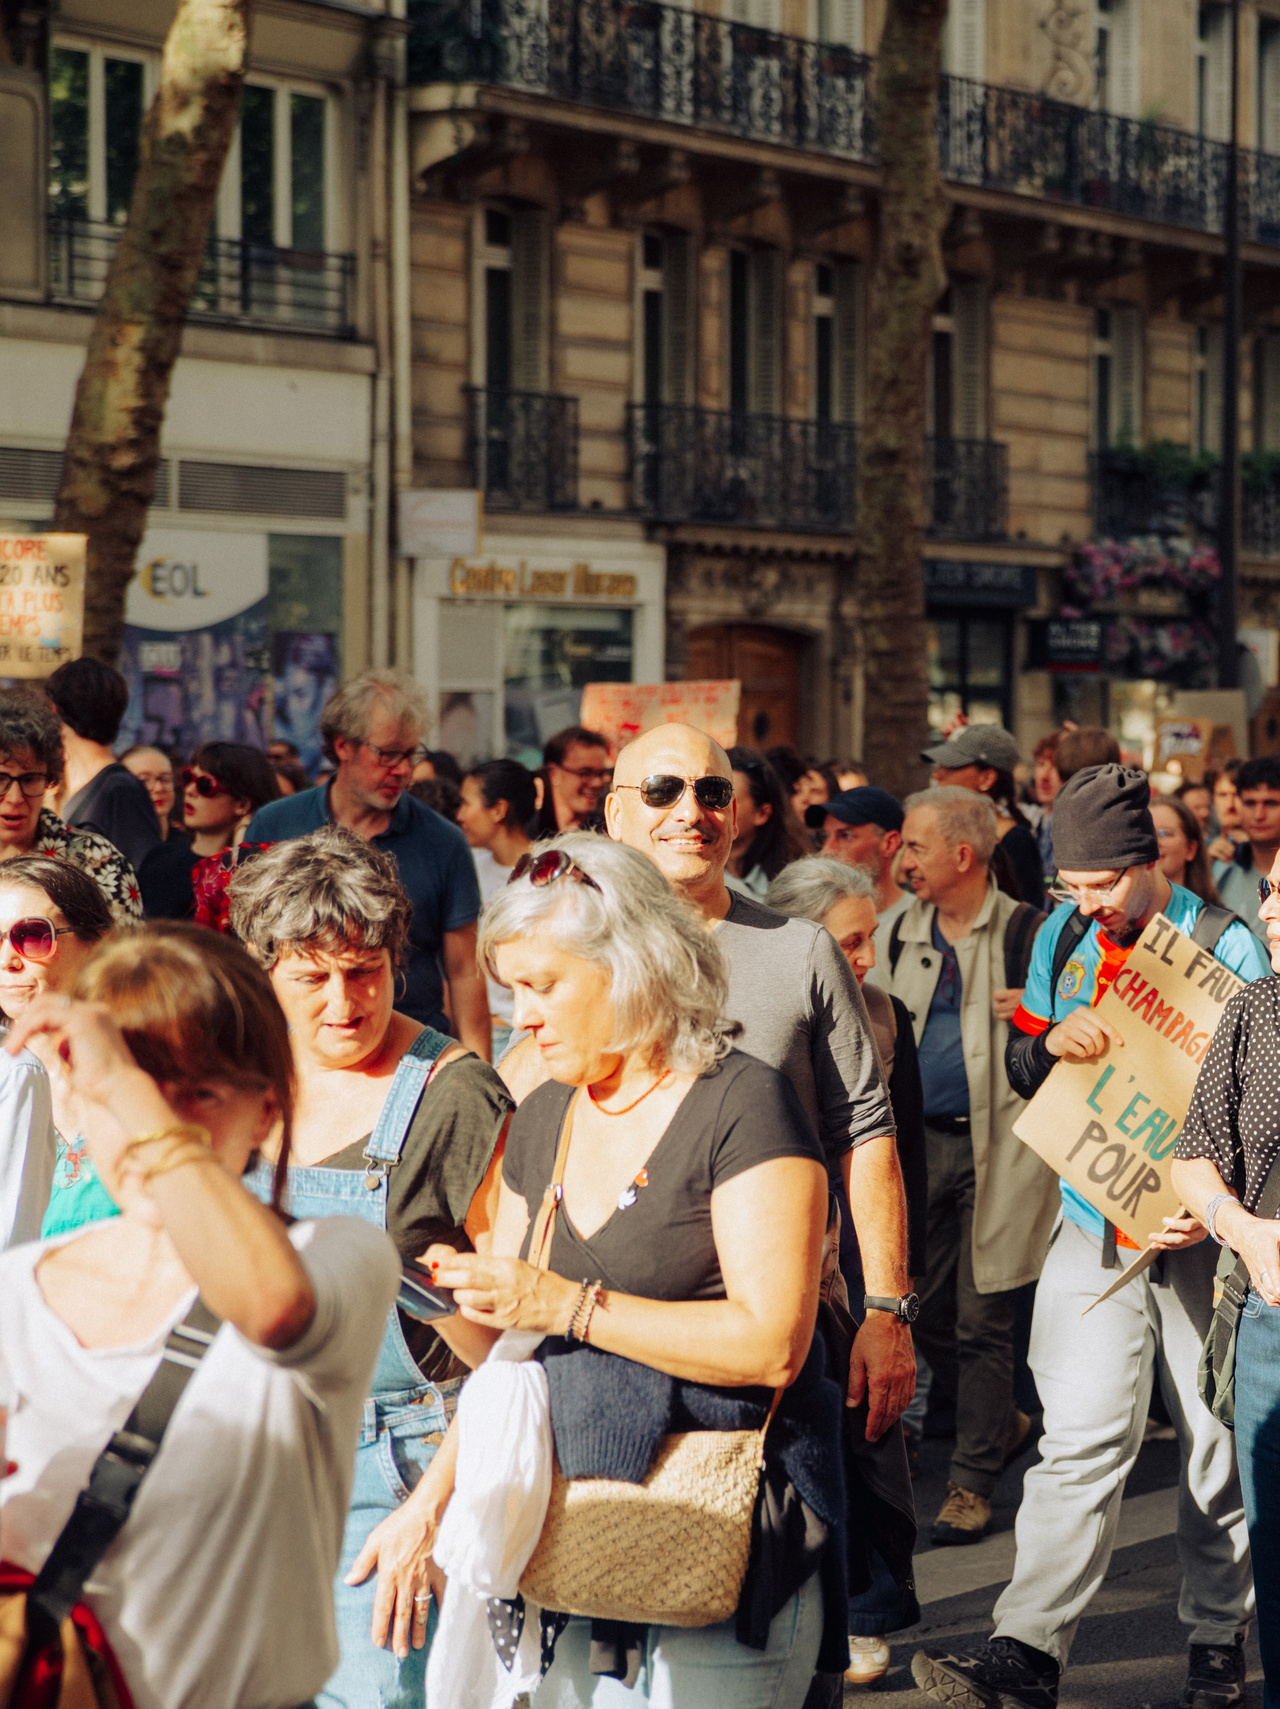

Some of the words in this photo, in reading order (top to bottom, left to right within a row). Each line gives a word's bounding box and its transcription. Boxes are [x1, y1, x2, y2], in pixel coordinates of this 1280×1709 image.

[0, 538, 47, 560] CORE
[32, 564, 70, 587] ANS
[23, 592, 63, 613] PLUS
[1142, 918, 1177, 967] IL
[1085, 1063, 1181, 1162] L'EAU
[1065, 1119, 1162, 1220] POUR
